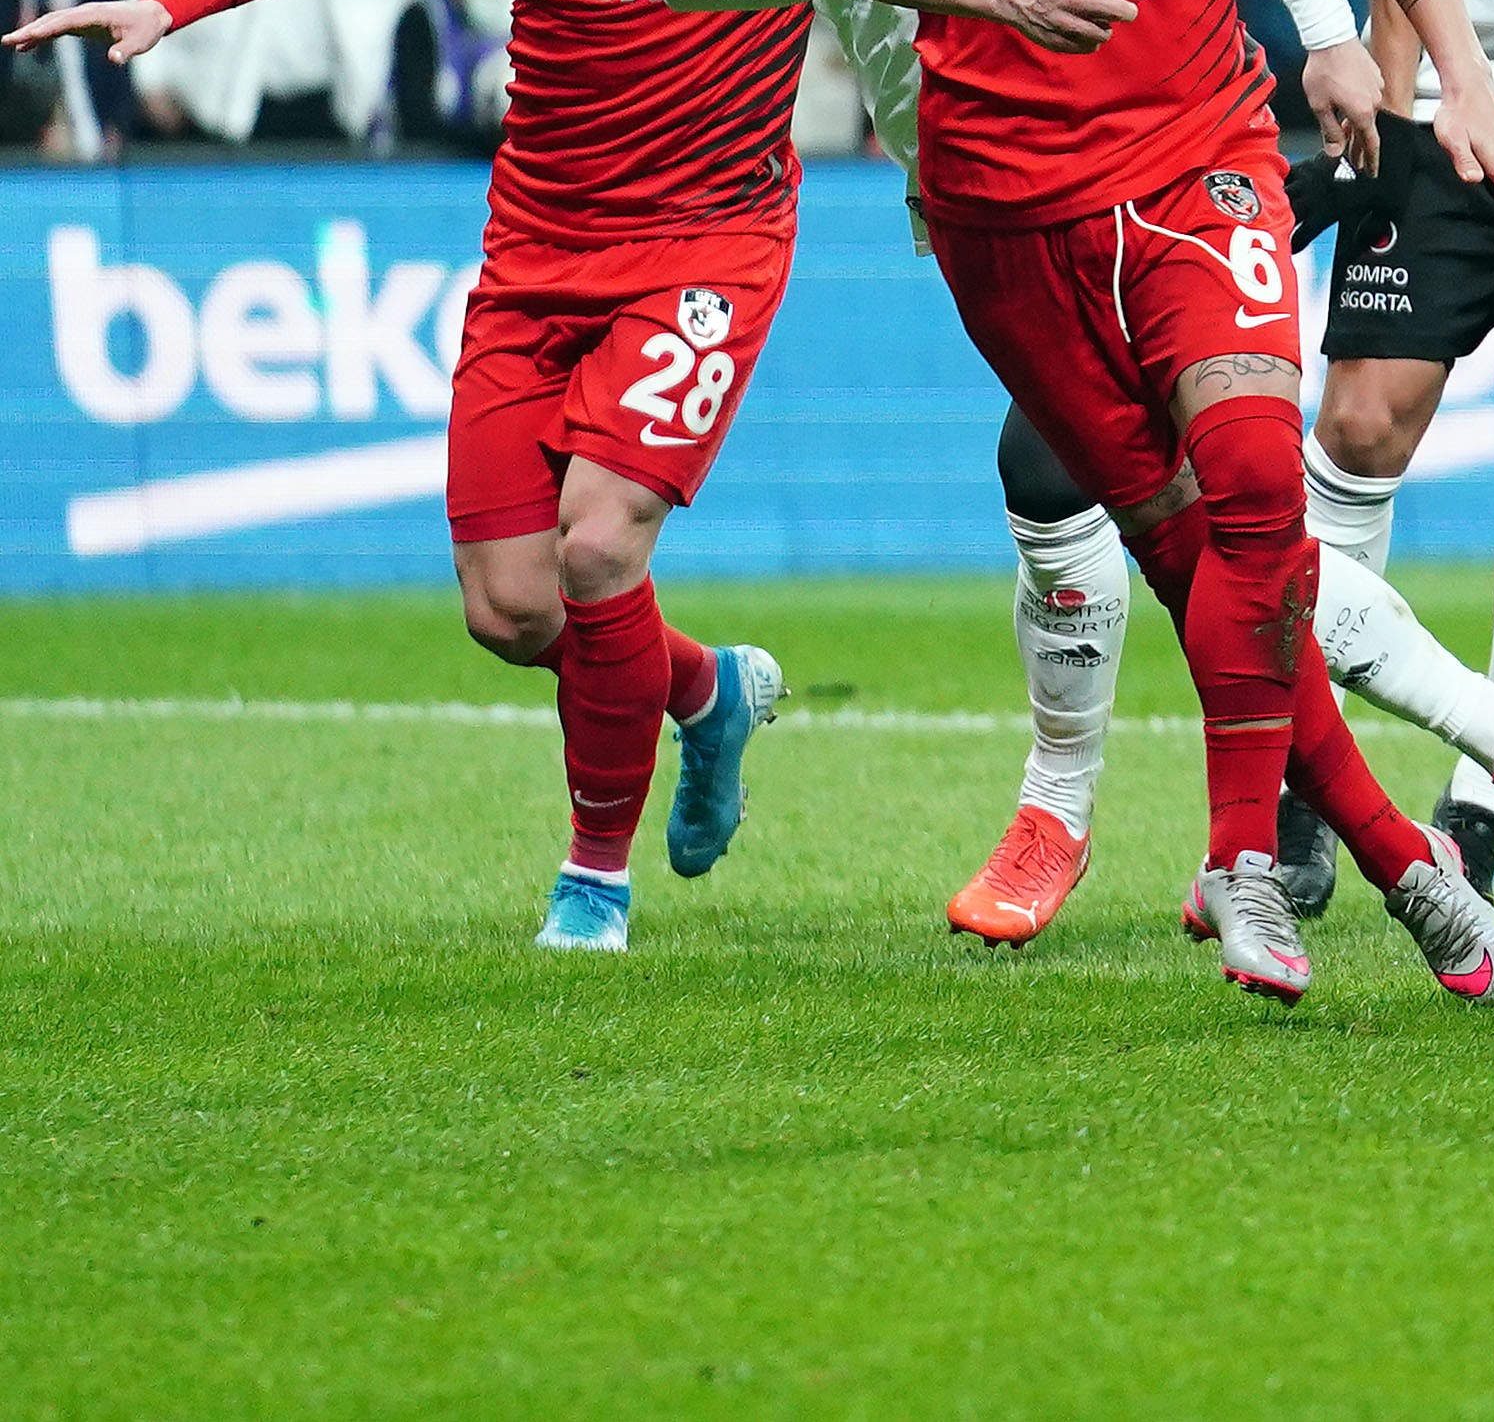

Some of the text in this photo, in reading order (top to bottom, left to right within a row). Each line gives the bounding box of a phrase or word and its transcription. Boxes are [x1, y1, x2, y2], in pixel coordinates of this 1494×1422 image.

[1228, 224, 1283, 304] 6
[1345, 264, 1409, 285] SOMPO
[619, 332, 736, 436] 28
